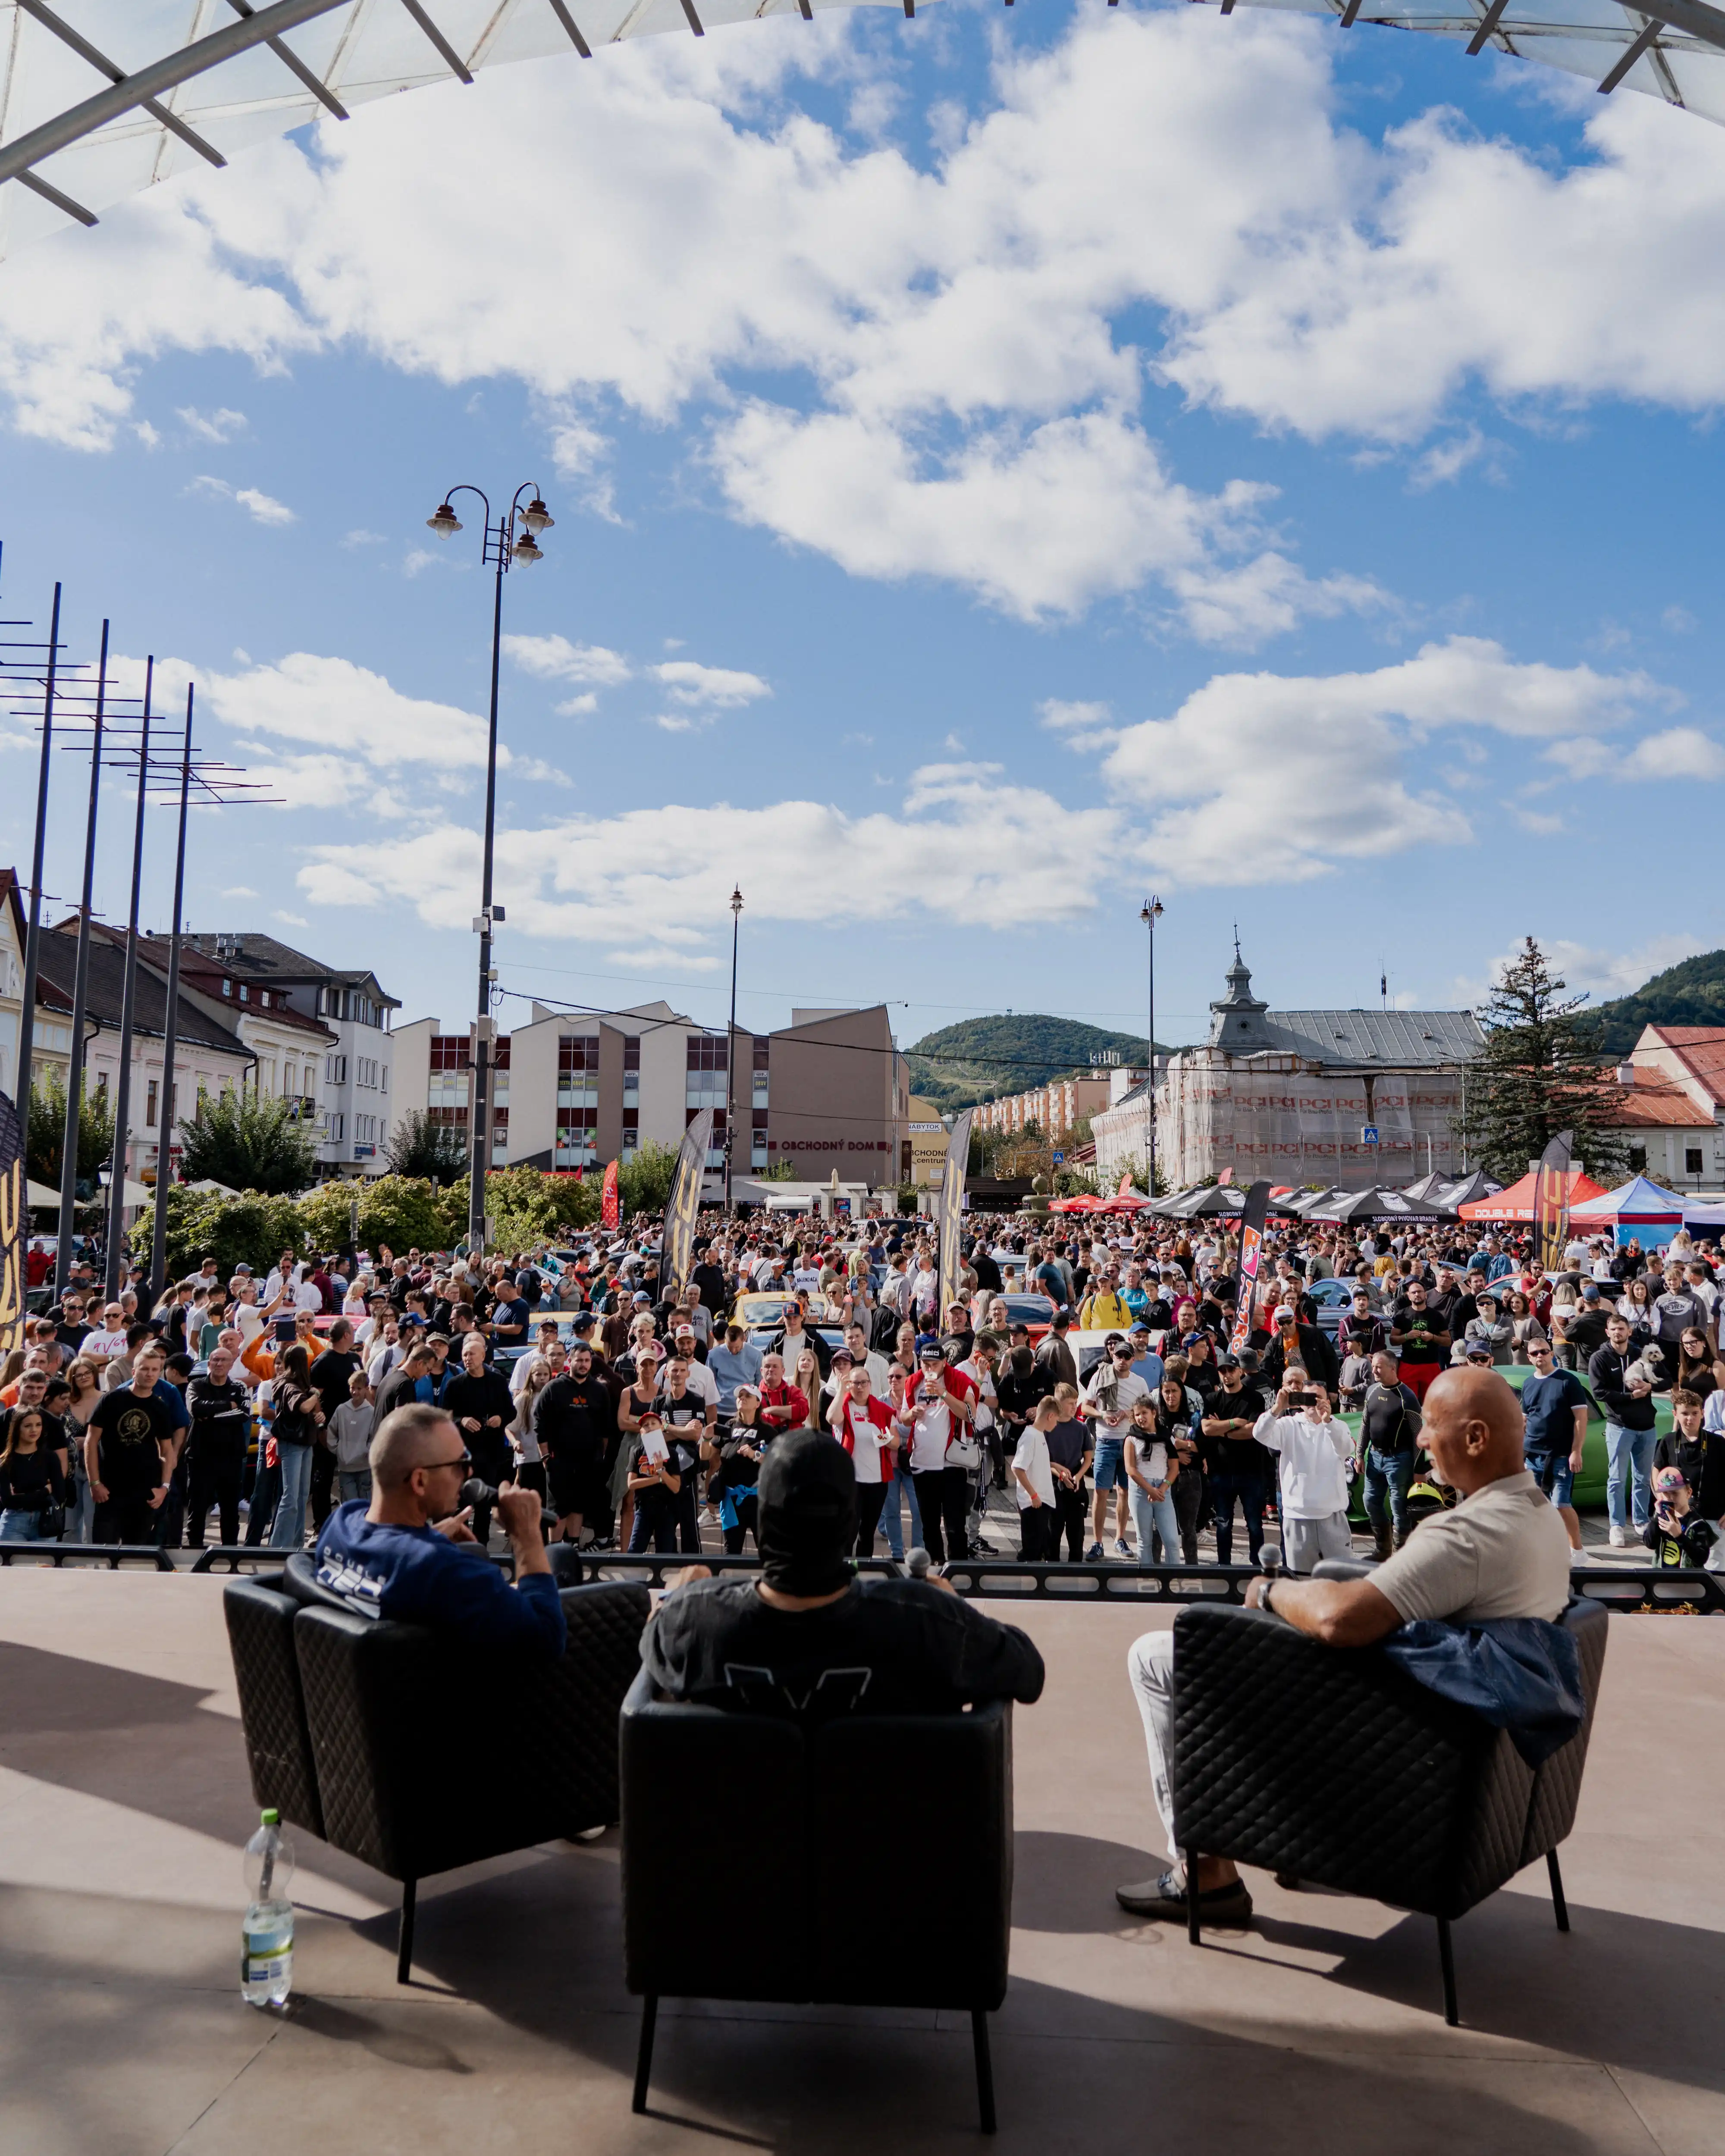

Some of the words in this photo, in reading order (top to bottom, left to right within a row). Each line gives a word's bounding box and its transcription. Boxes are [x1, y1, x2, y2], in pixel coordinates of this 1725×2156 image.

[1234, 1097, 1267, 1106] PCI
[1299, 1099, 1331, 1109] PCI
[1374, 1096, 1404, 1108] PCI
[1416, 1096, 1449, 1105] PCI
[781, 1139, 844, 1150] OBCHODNÝ
[848, 1141, 875, 1150] DOM
[1236, 1144, 1268, 1153] PCI
[1272, 1144, 1299, 1153] PCI
[1304, 1144, 1336, 1153] PCI
[1340, 1144, 1373, 1153] PCI
[1378, 1141, 1412, 1152] PCI
[1475, 1209, 1513, 1218] DOUBLE
[324, 1545, 386, 1585] DOUBLE
